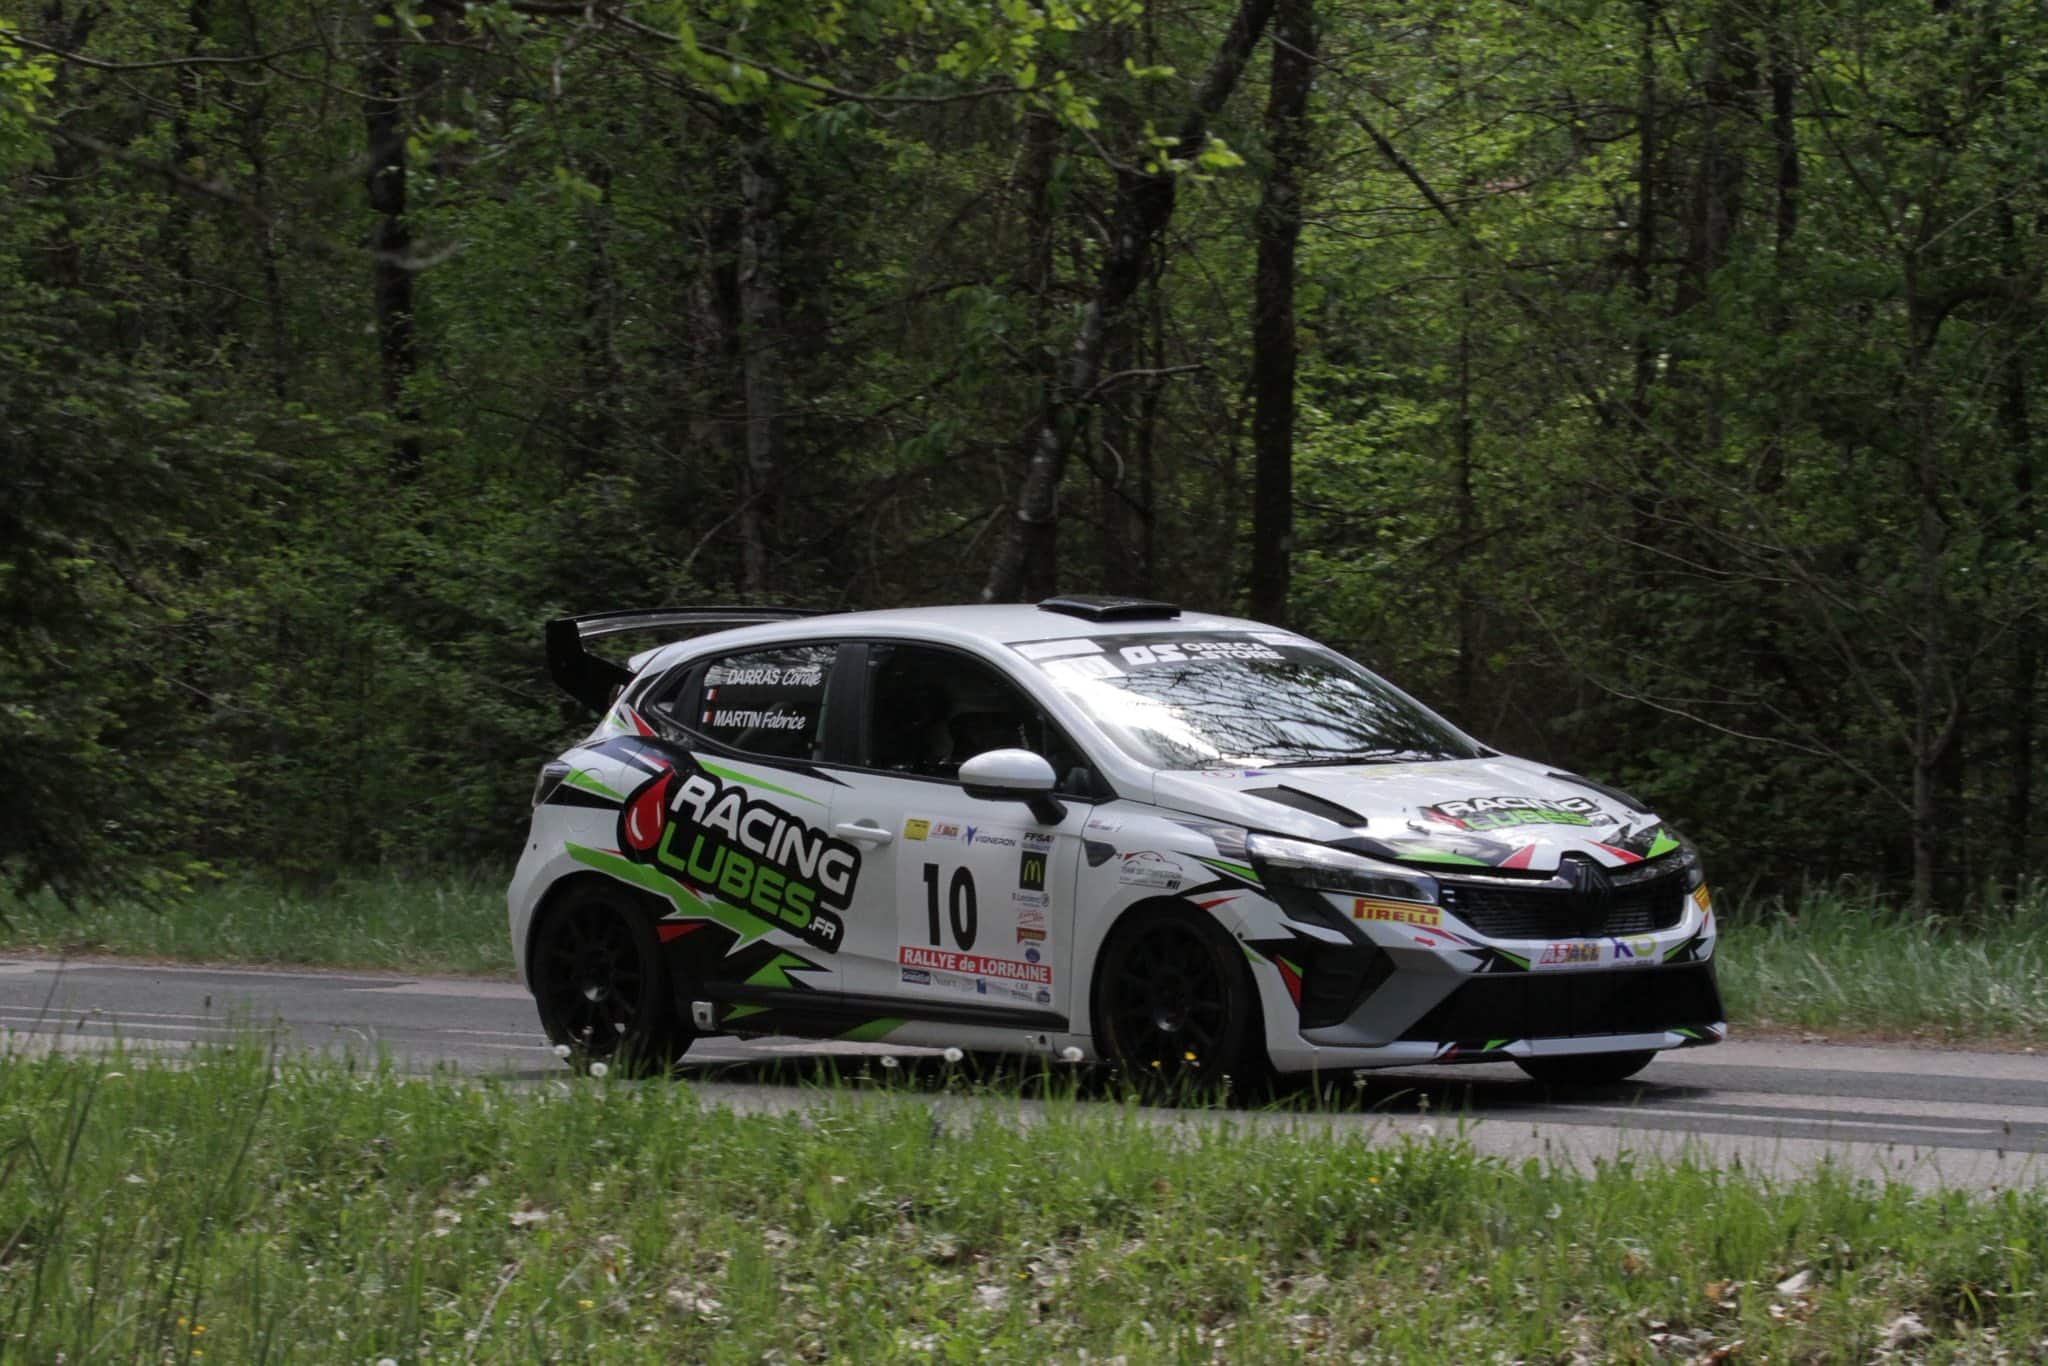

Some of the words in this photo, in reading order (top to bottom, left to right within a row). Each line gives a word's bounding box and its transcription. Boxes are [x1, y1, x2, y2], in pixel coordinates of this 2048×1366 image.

[726, 669, 781, 685] DARRAS
[713, 710, 762, 727] MARTIN
[762, 710, 806, 729] Fabrice
[1438, 798, 1592, 816] RACING
[669, 774, 855, 895] RACING
[924, 863, 977, 951] 10
[1355, 899, 1439, 926] PIRELLI
[903, 948, 956, 968] RALLYE
[959, 955, 976, 971] de
[979, 959, 1049, 981] LORRAINE
